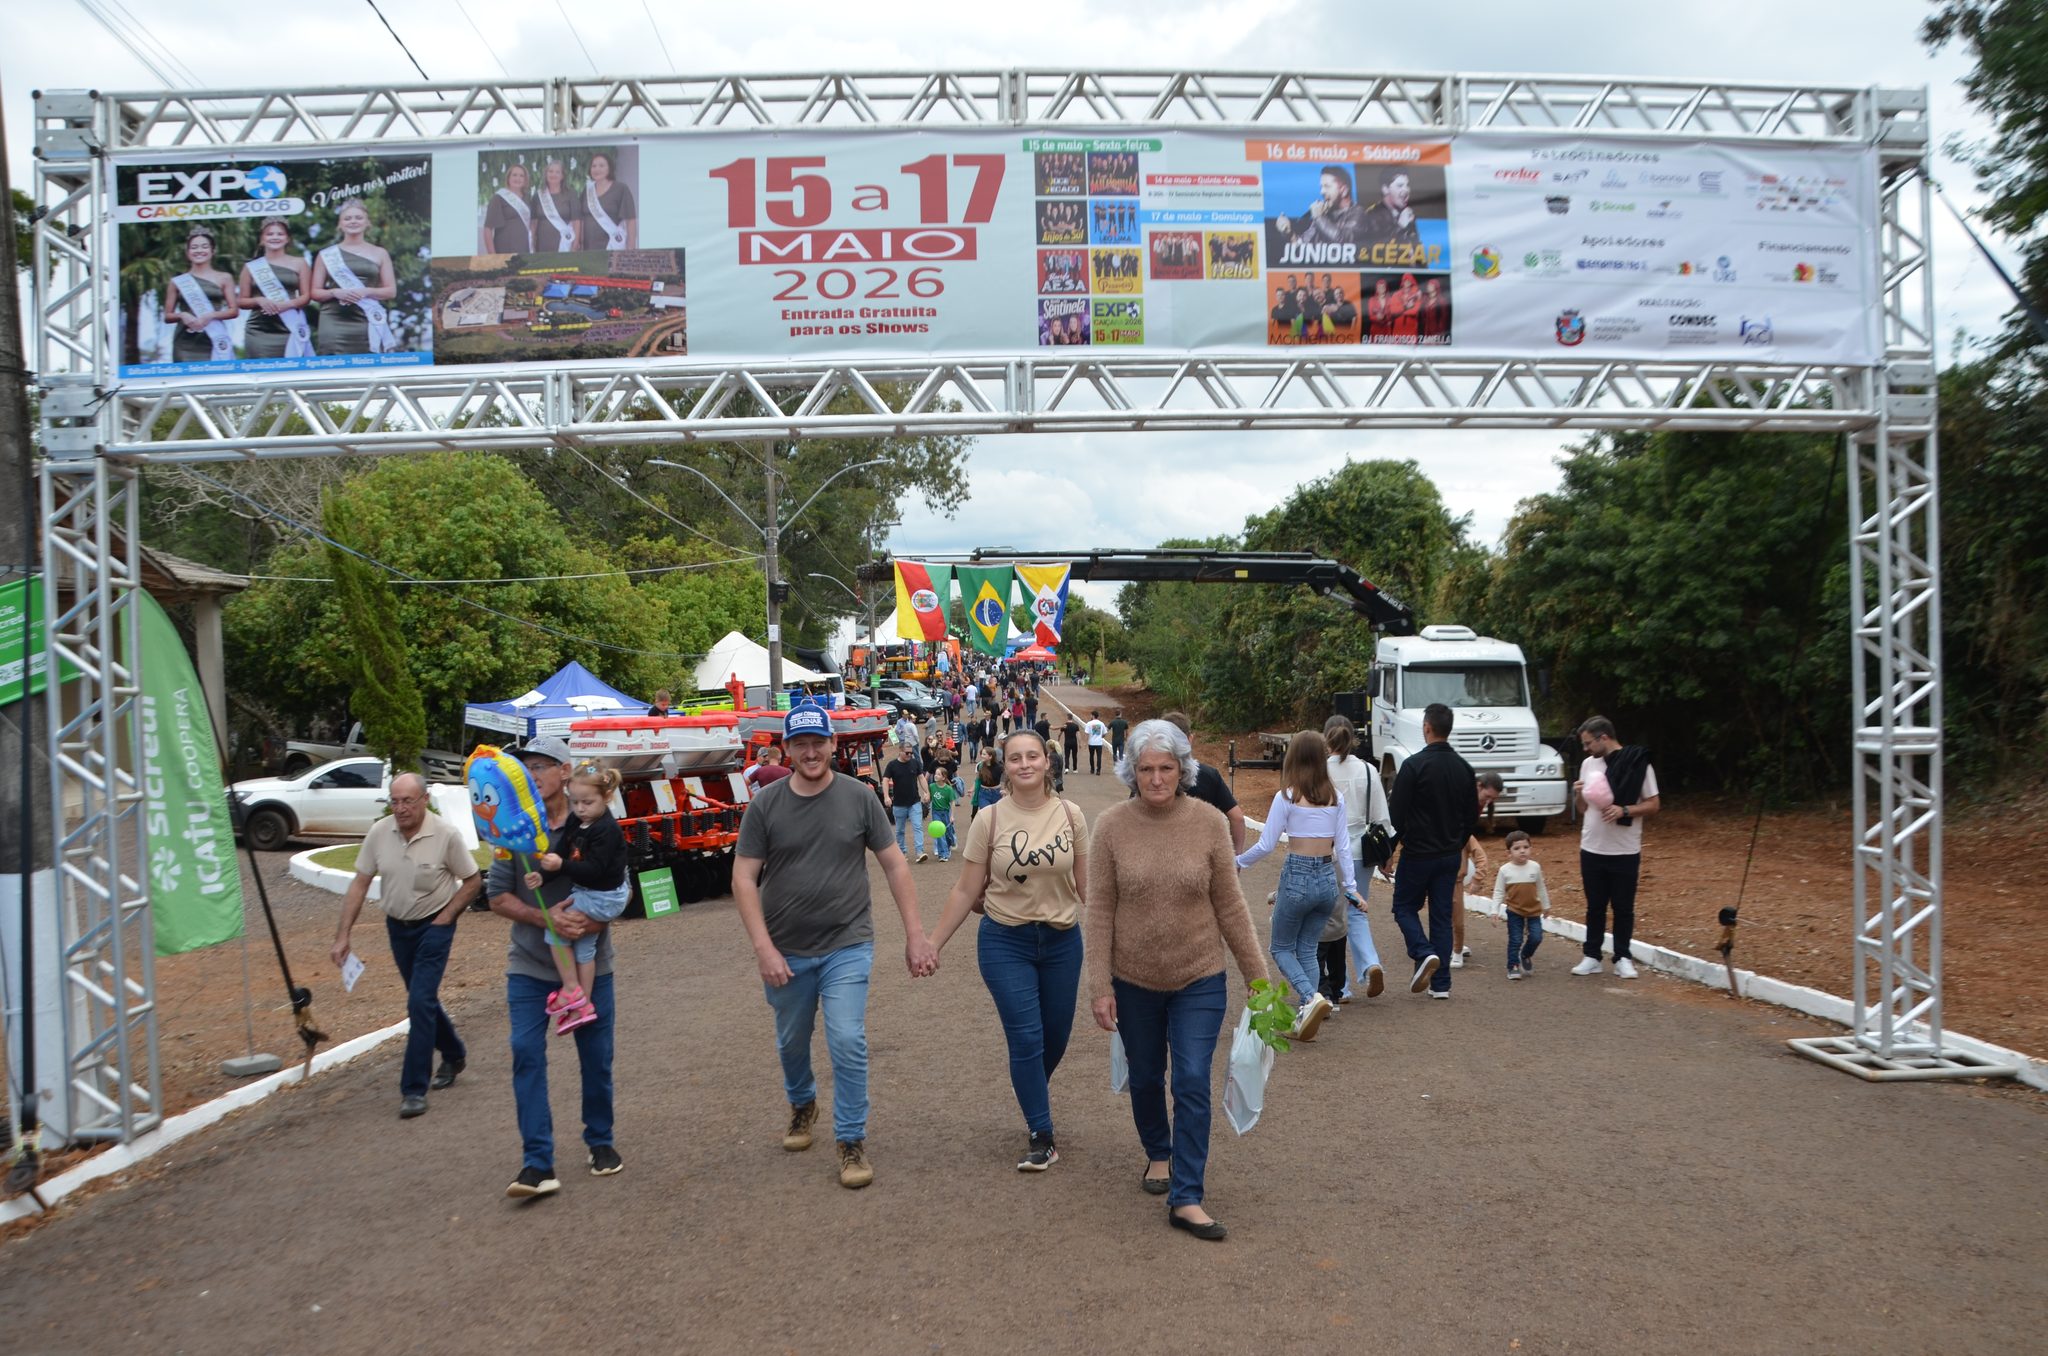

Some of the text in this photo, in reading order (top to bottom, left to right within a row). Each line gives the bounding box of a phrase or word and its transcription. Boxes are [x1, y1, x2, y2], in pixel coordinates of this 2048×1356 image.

[1029, 140, 1040, 150] 15
[1042, 140, 1055, 150] de
[1057, 140, 1083, 150] maio
[1266, 143, 1283, 159] 16
[1286, 144, 1305, 159] de
[1309, 144, 1348, 160] maio
[311, 161, 428, 208] Venha nos visitar!
[709, 153, 1006, 228] 15 a 17
[137, 199, 290, 220] CAIÇARA 2026
[1152, 212, 1161, 221] 17
[1163, 212, 1175, 221] de
[1177, 212, 1202, 221] maio
[1211, 211, 1254, 223] Domingo
[751, 230, 965, 261] MAIO
[1071, 229, 1084, 241] Sul
[1370, 238, 1441, 265] CÉZAR
[1211, 259, 1253, 279] Hello
[773, 266, 945, 301] 2026
[781, 306, 937, 320] Entrada Gratuita
[1043, 298, 1086, 319] Sentinela
[790, 322, 929, 337] para os Shows
[174, 687, 204, 790] COOPERA
[570, 741, 608, 750] magnum
[1006, 830, 1069, 881] love
